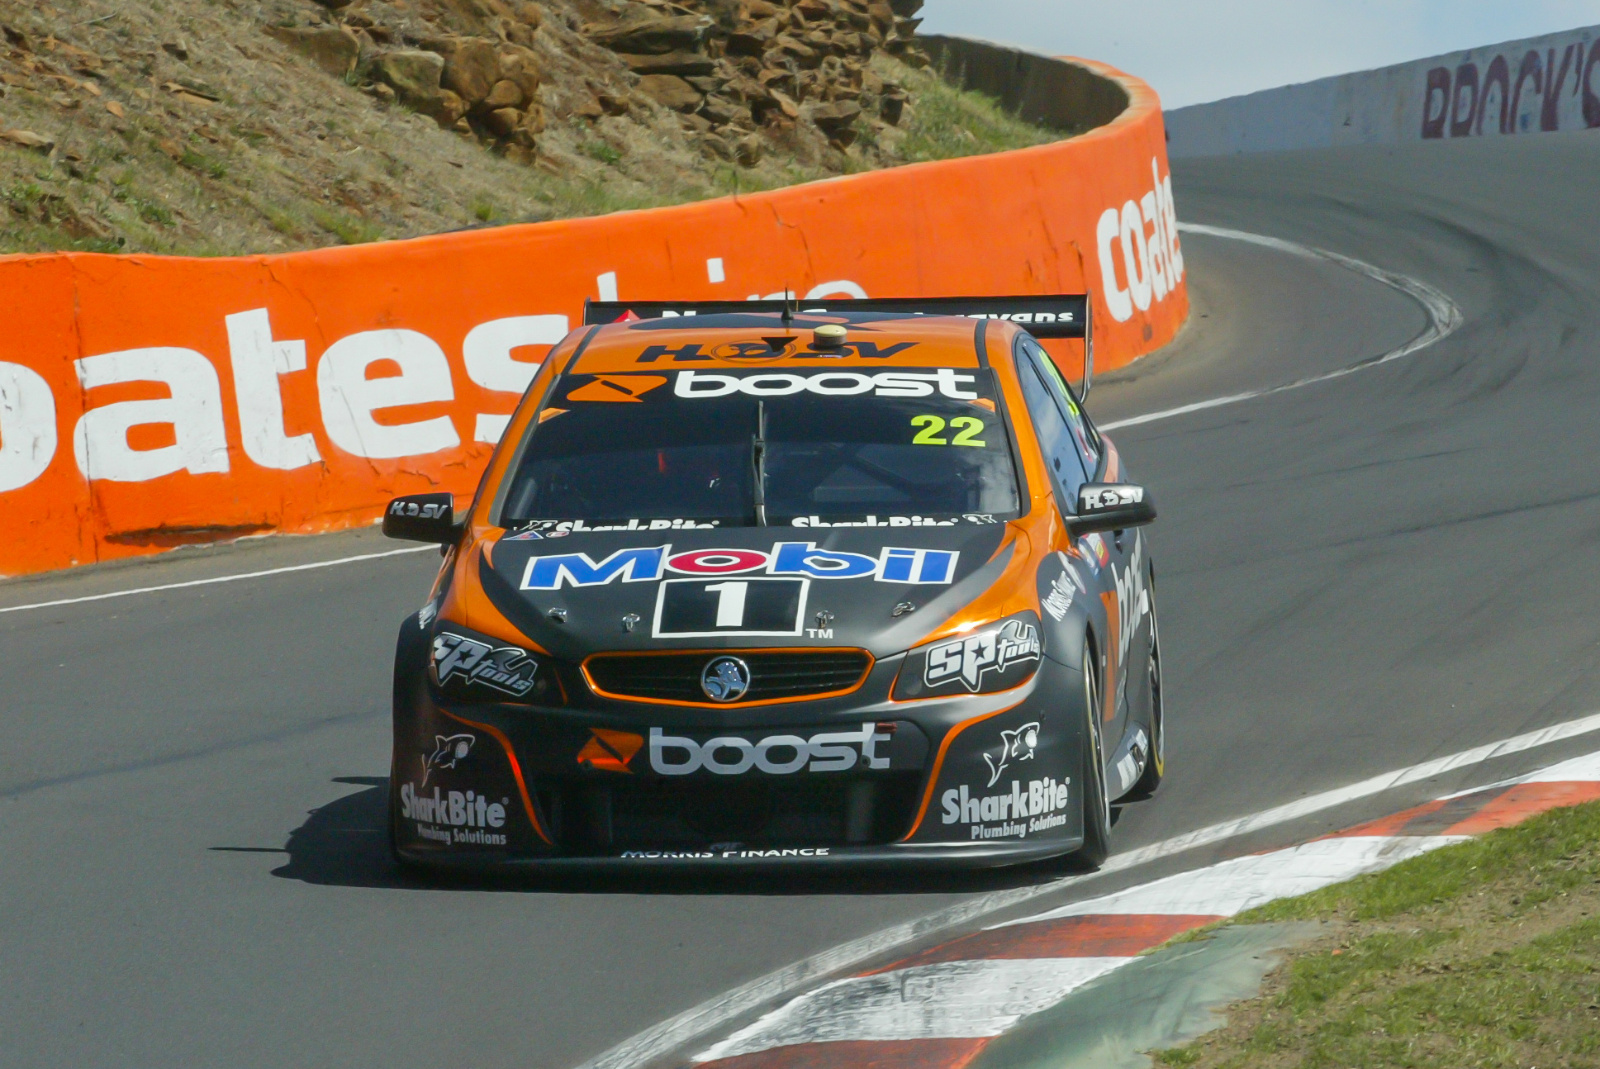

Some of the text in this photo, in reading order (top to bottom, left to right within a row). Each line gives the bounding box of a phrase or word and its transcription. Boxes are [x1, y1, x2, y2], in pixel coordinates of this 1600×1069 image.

[674, 368, 978, 399] boost
[910, 414, 986, 448] 22
[519, 541, 961, 590] Mobil
[704, 581, 748, 627] 1
[806, 628, 834, 640] TM
[928, 632, 997, 686] SP
[649, 721, 891, 776] boost
[400, 781, 506, 828] SharkBite
[941, 776, 1068, 825] SharkBite
[453, 828, 507, 845] Solutions
[971, 812, 1067, 839] Plumbing Solutions
[722, 847, 830, 858] FINANCE
